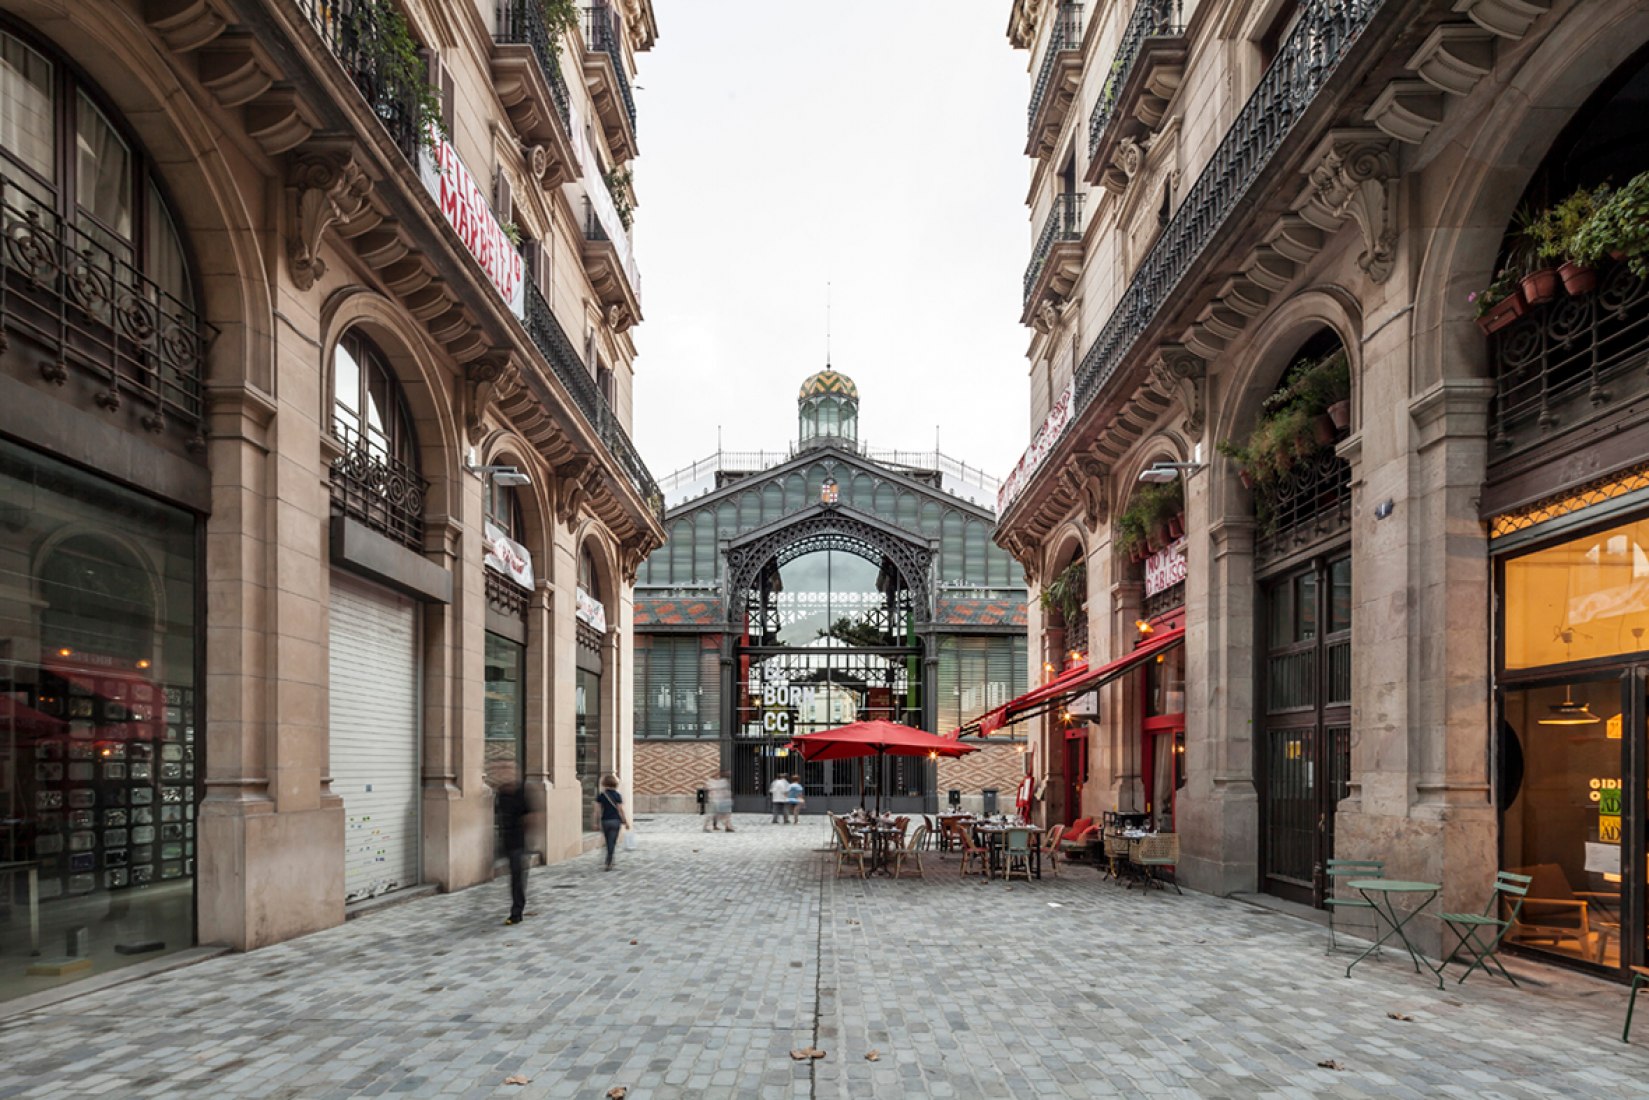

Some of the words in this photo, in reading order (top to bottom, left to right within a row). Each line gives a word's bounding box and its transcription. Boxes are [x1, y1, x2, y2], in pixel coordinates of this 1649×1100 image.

[440, 174, 512, 305] MARBELLA
[764, 660, 786, 680] EL
[764, 685, 815, 706] BORN
[764, 711, 789, 731] CC
